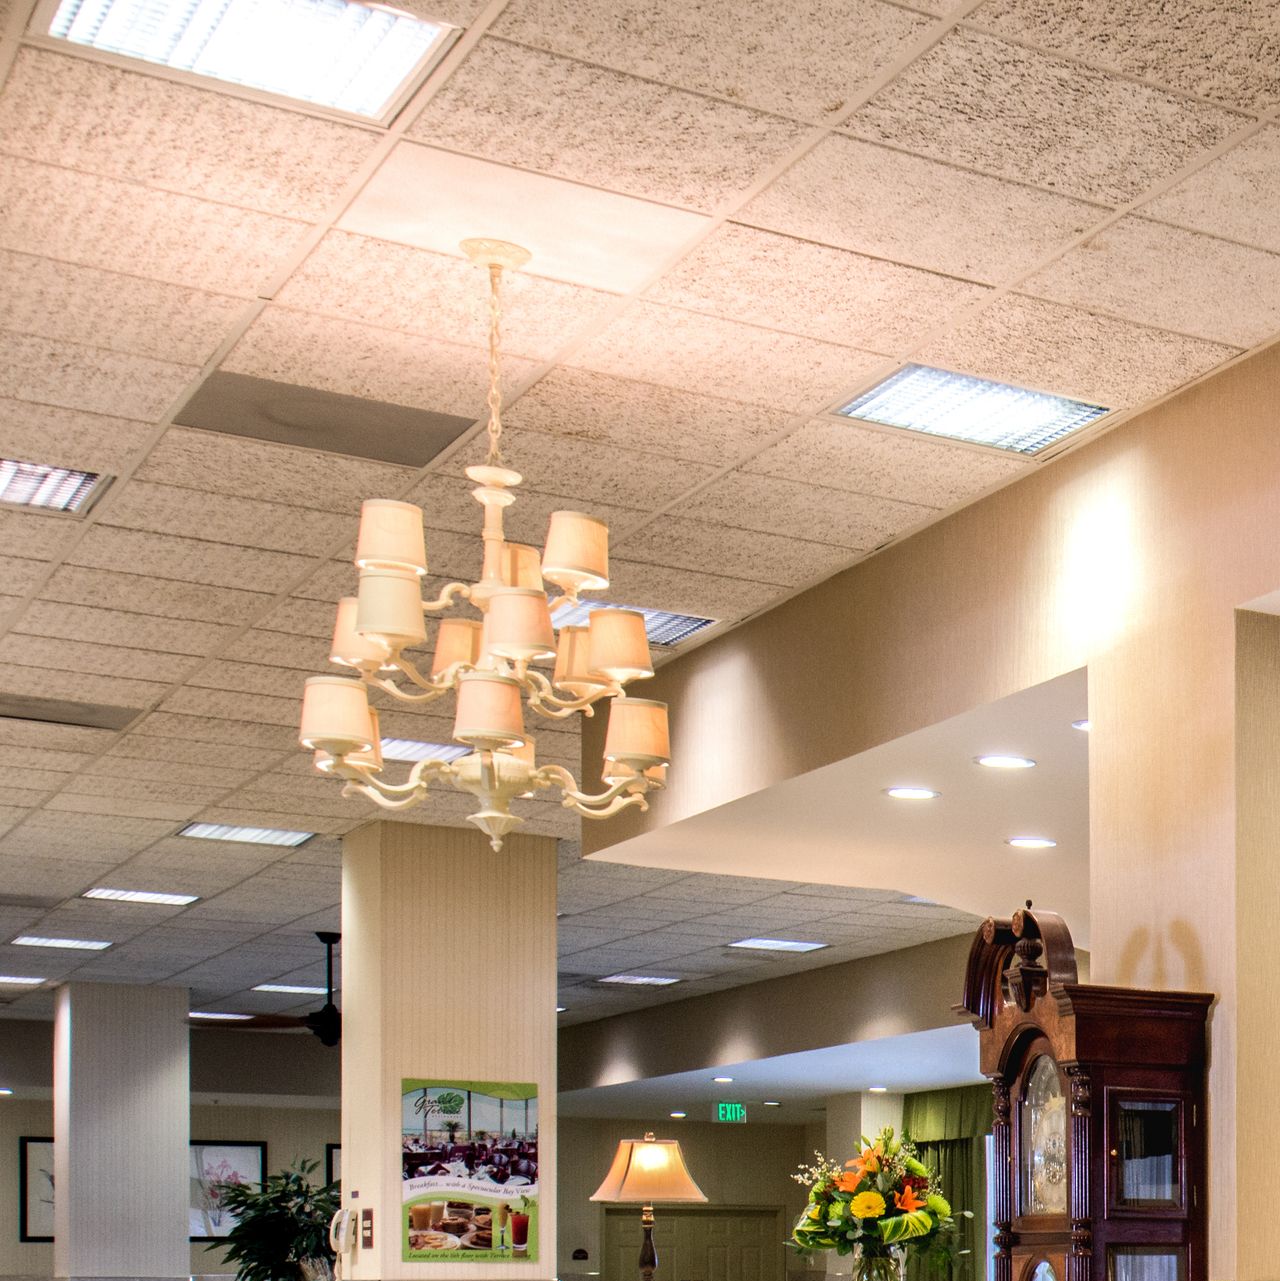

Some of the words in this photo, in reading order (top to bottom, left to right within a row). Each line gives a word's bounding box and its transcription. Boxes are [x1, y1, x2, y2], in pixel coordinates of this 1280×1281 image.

[718, 1103, 742, 1121] EXIT
[445, 1181, 461, 1189] with
[468, 1183, 502, 1194] Spectacular
[502, 1187, 514, 1196] Bay
[515, 1187, 531, 1195] View
